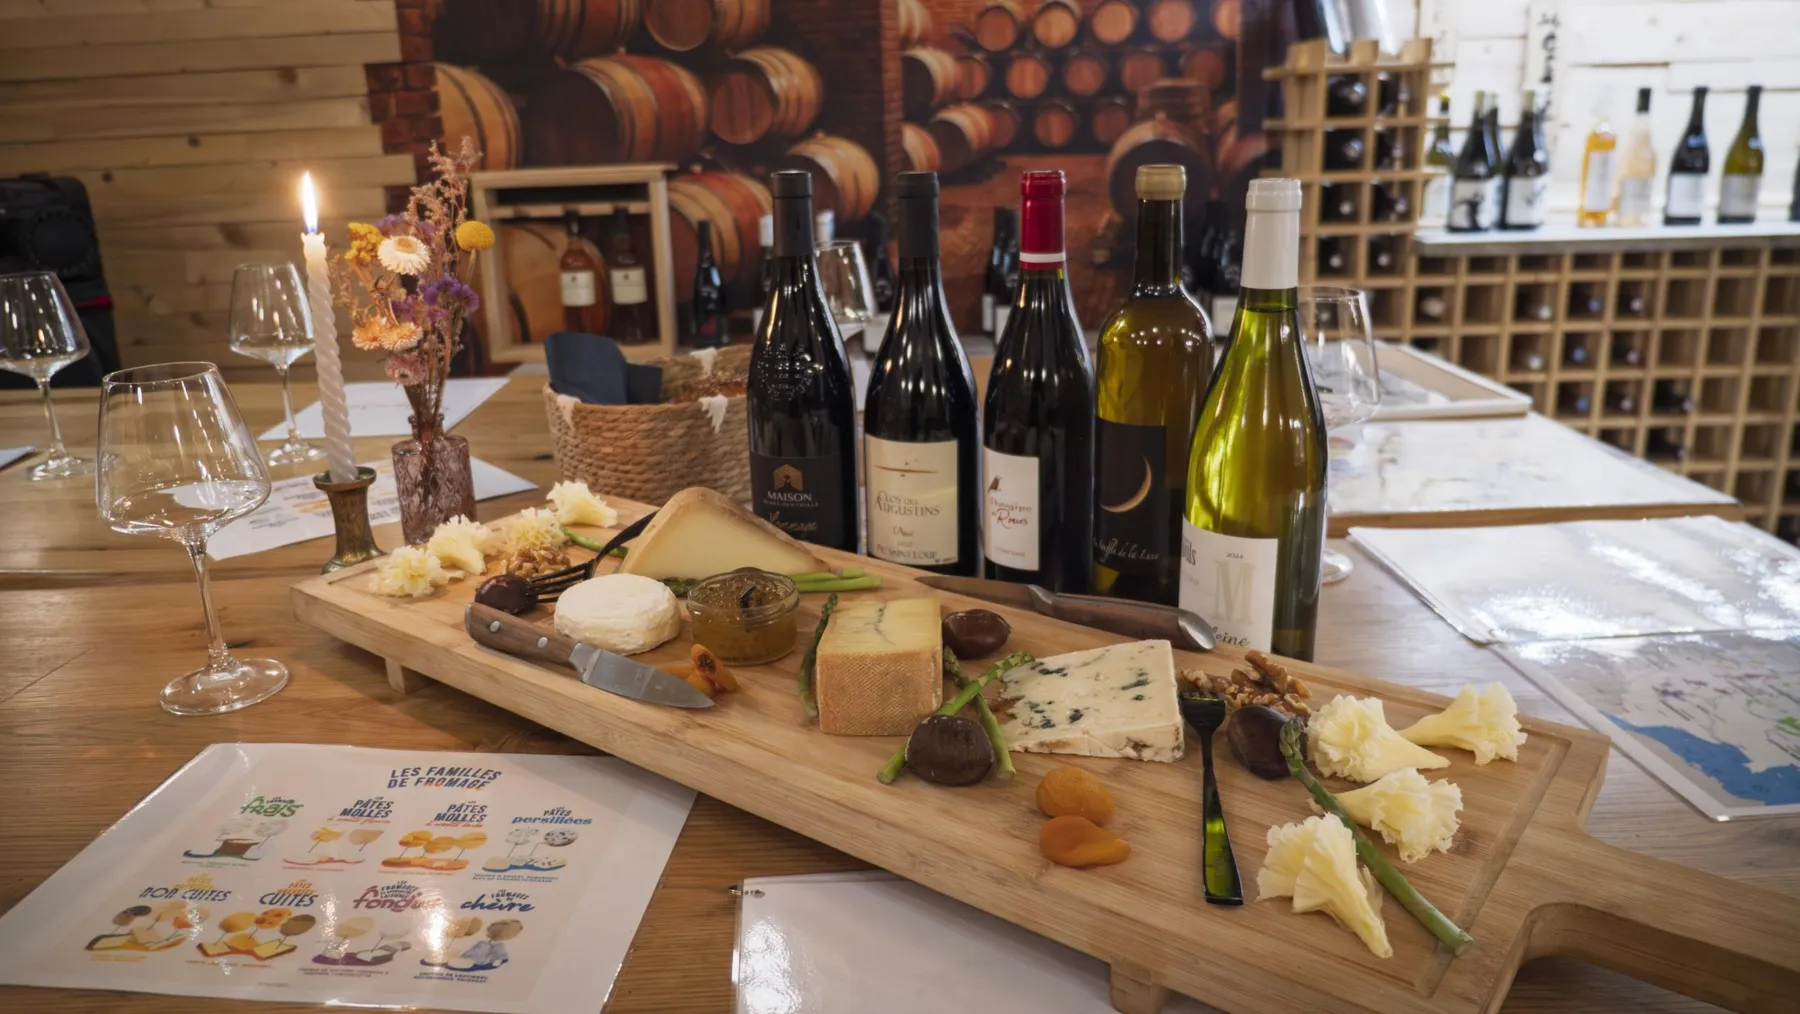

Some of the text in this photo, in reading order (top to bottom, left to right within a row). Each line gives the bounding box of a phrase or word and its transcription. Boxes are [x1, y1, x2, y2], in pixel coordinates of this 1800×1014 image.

[767, 490, 813, 502] MAISON
[875, 496, 941, 517] AUGUSTINS
[1209, 559, 1257, 625] M
[390, 766, 502, 781] LES FAMILLES
[387, 777, 491, 791] DE FROMAGE
[353, 798, 395, 810] PÂTES
[447, 802, 488, 814] PÂTES
[339, 807, 393, 819] MOLLES
[433, 813, 488, 823] MOLLES
[511, 816, 593, 825] persillées
[180, 888, 233, 902] CUITES
[259, 892, 319, 907] CUITES
[460, 893, 535, 912] chèvre
